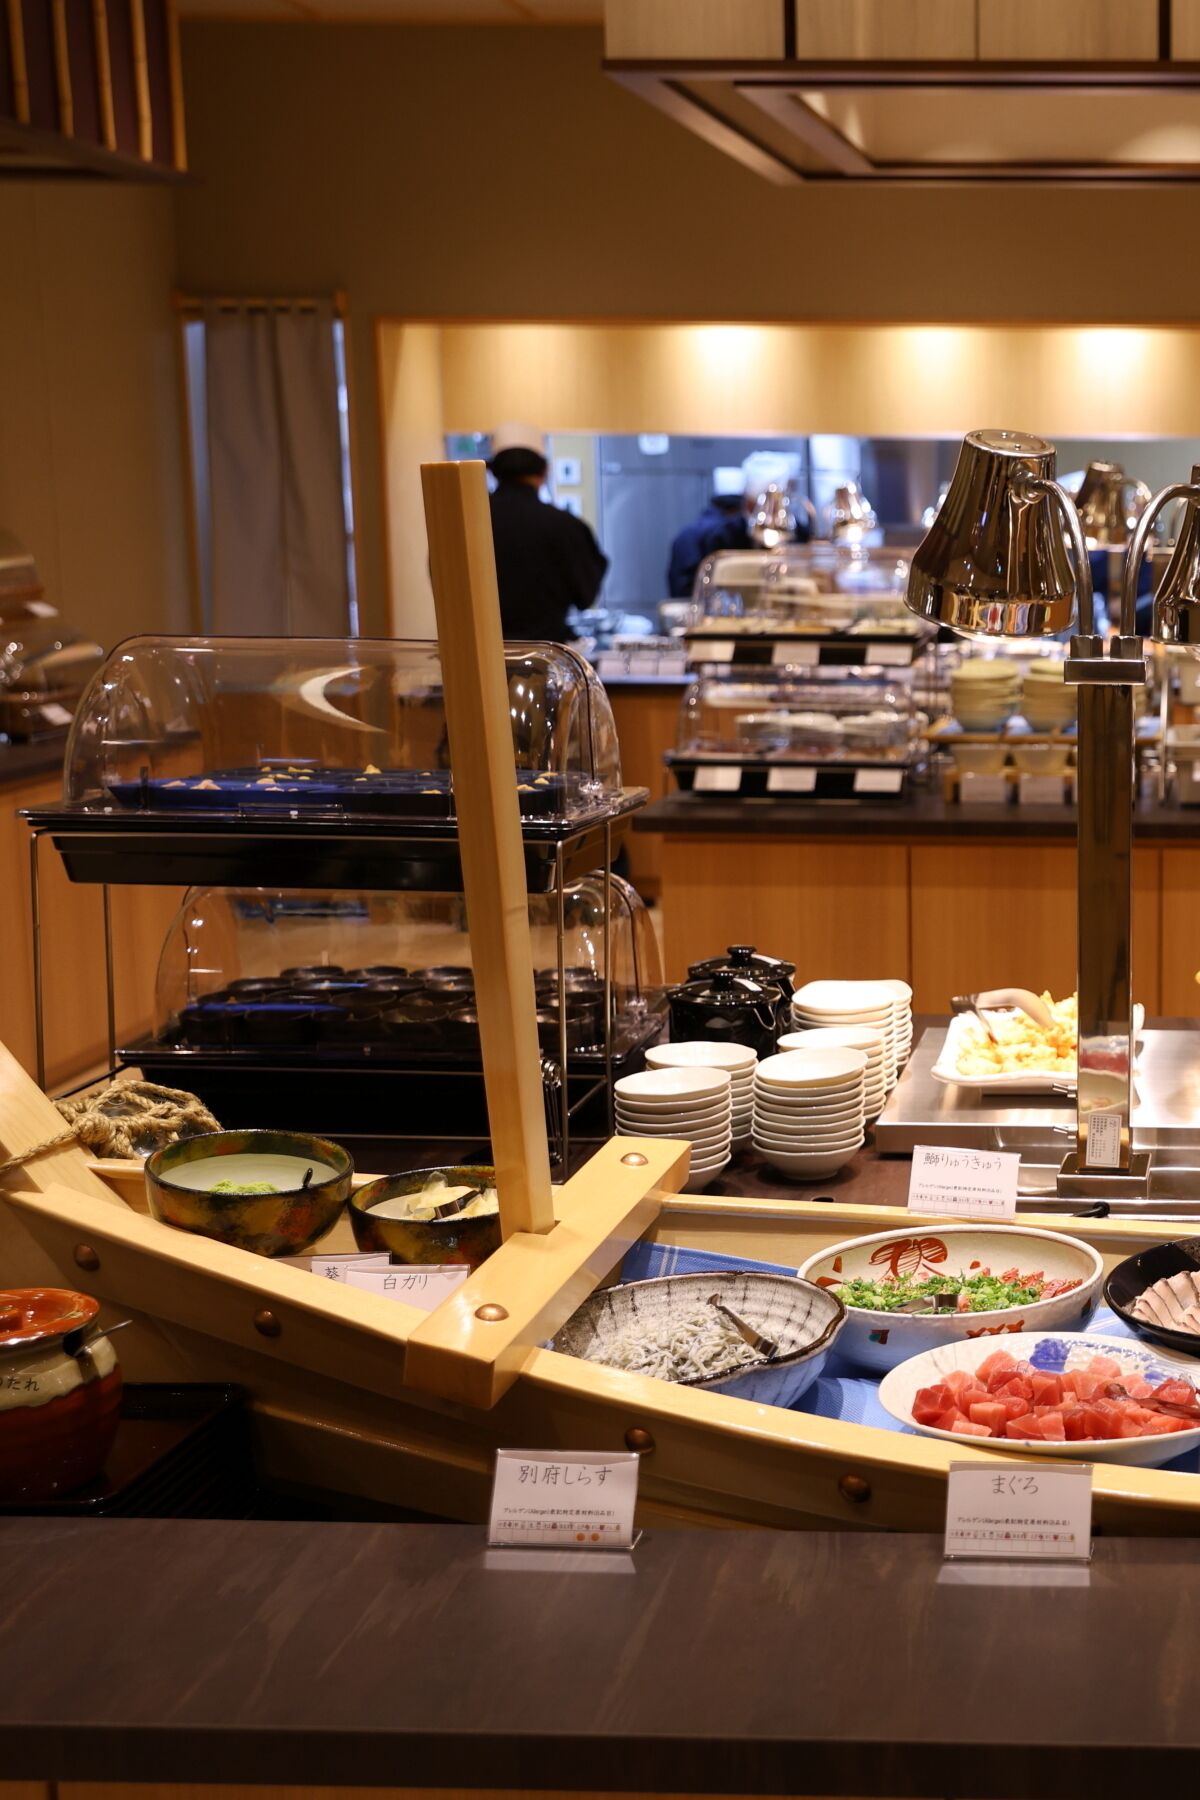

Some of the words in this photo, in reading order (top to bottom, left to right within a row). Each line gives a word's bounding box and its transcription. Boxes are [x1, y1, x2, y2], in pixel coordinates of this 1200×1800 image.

[923, 1152, 1002, 1171] 鰤りゅうきゅう
[383, 1274, 429, 1291] 白ガリ
[0, 1376, 40, 1392] たれ
[518, 1464, 613, 1486] 別府しらす
[991, 1474, 1040, 1496] まぐろ
